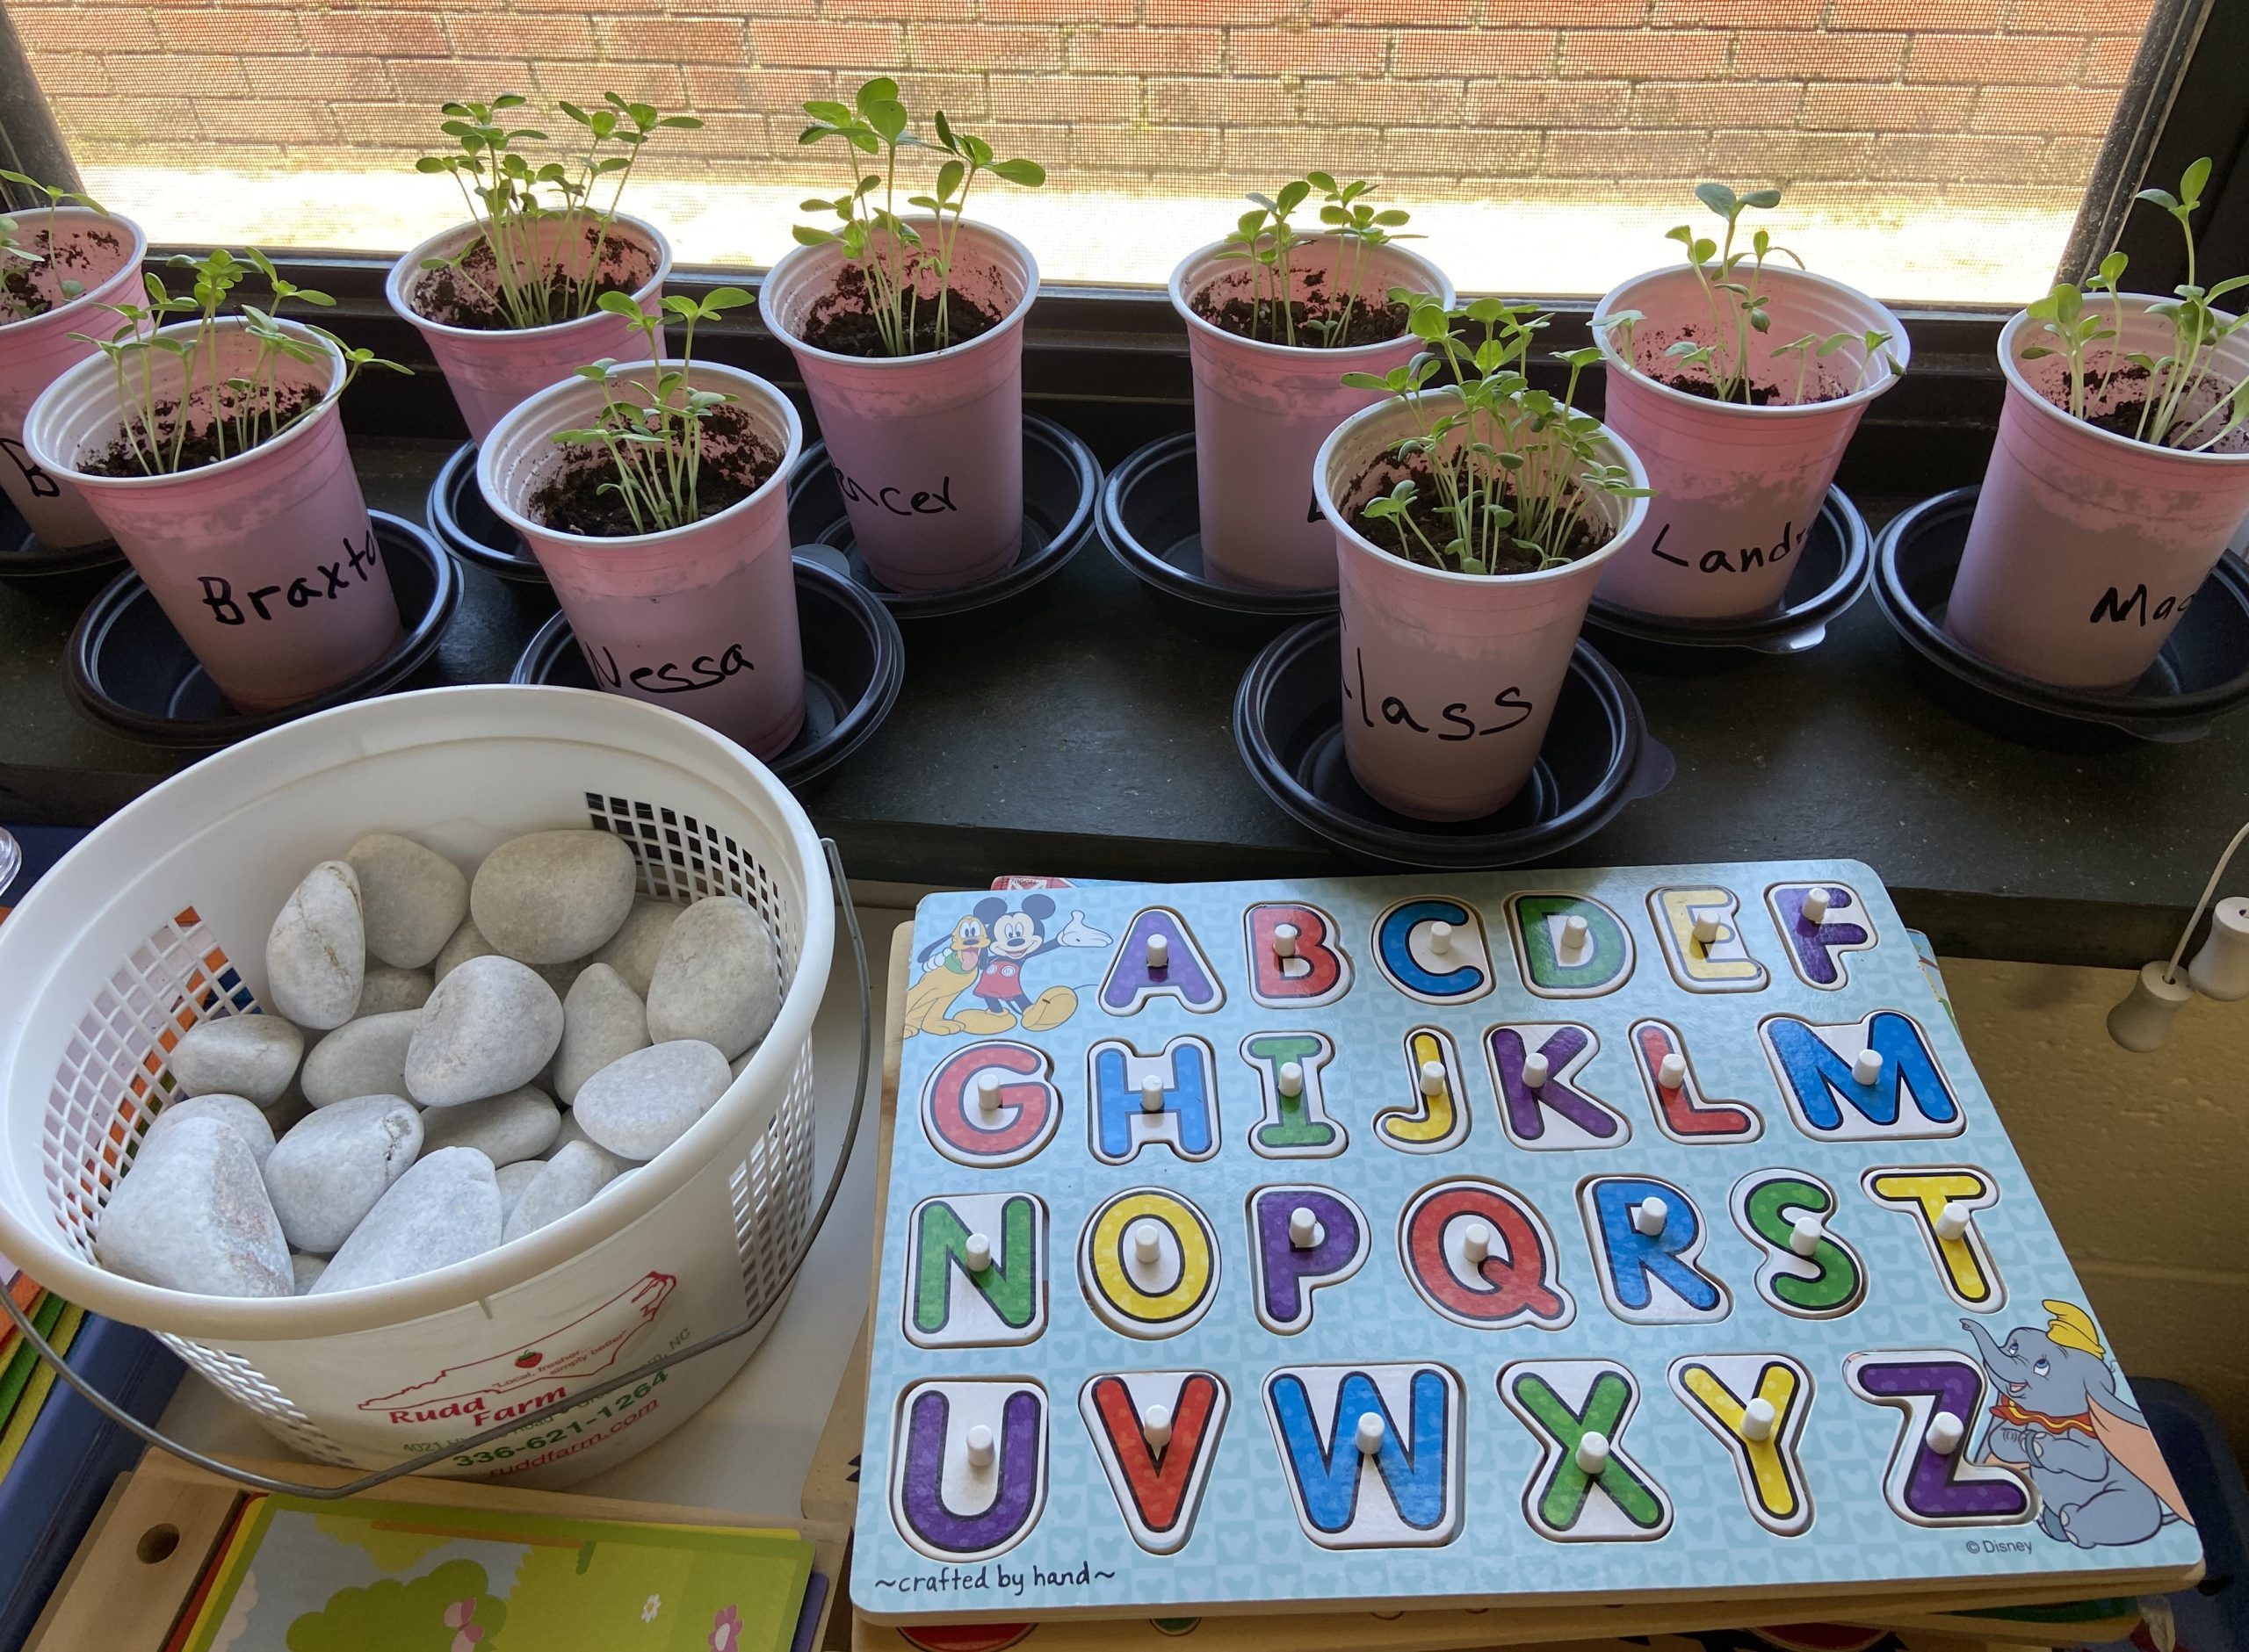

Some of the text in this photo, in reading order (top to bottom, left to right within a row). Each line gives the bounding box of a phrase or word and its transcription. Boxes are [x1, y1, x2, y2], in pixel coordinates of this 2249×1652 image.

[585, 641, 755, 694] Nessa
[1340, 608, 1533, 741] lass
[1103, 886, 1868, 1009] A B C D E F
[930, 1011, 1958, 1158] G H I J K L M
[913, 1171, 1991, 1335] N O P Q R S T
[550, 1355, 588, 1375] simply
[669, 1328, 691, 1350] NC
[389, 1397, 486, 1424] Rudd
[452, 1369, 669, 1467] 336-621-1264
[474, 1387, 567, 1427] Farm
[490, 1399, 658, 1478] ruddfarm.com
[901, 1360, 2029, 1554] U V W X Y Z
[997, 1564, 1023, 1596] by
[1983, 1540, 2032, 1555] Disney
